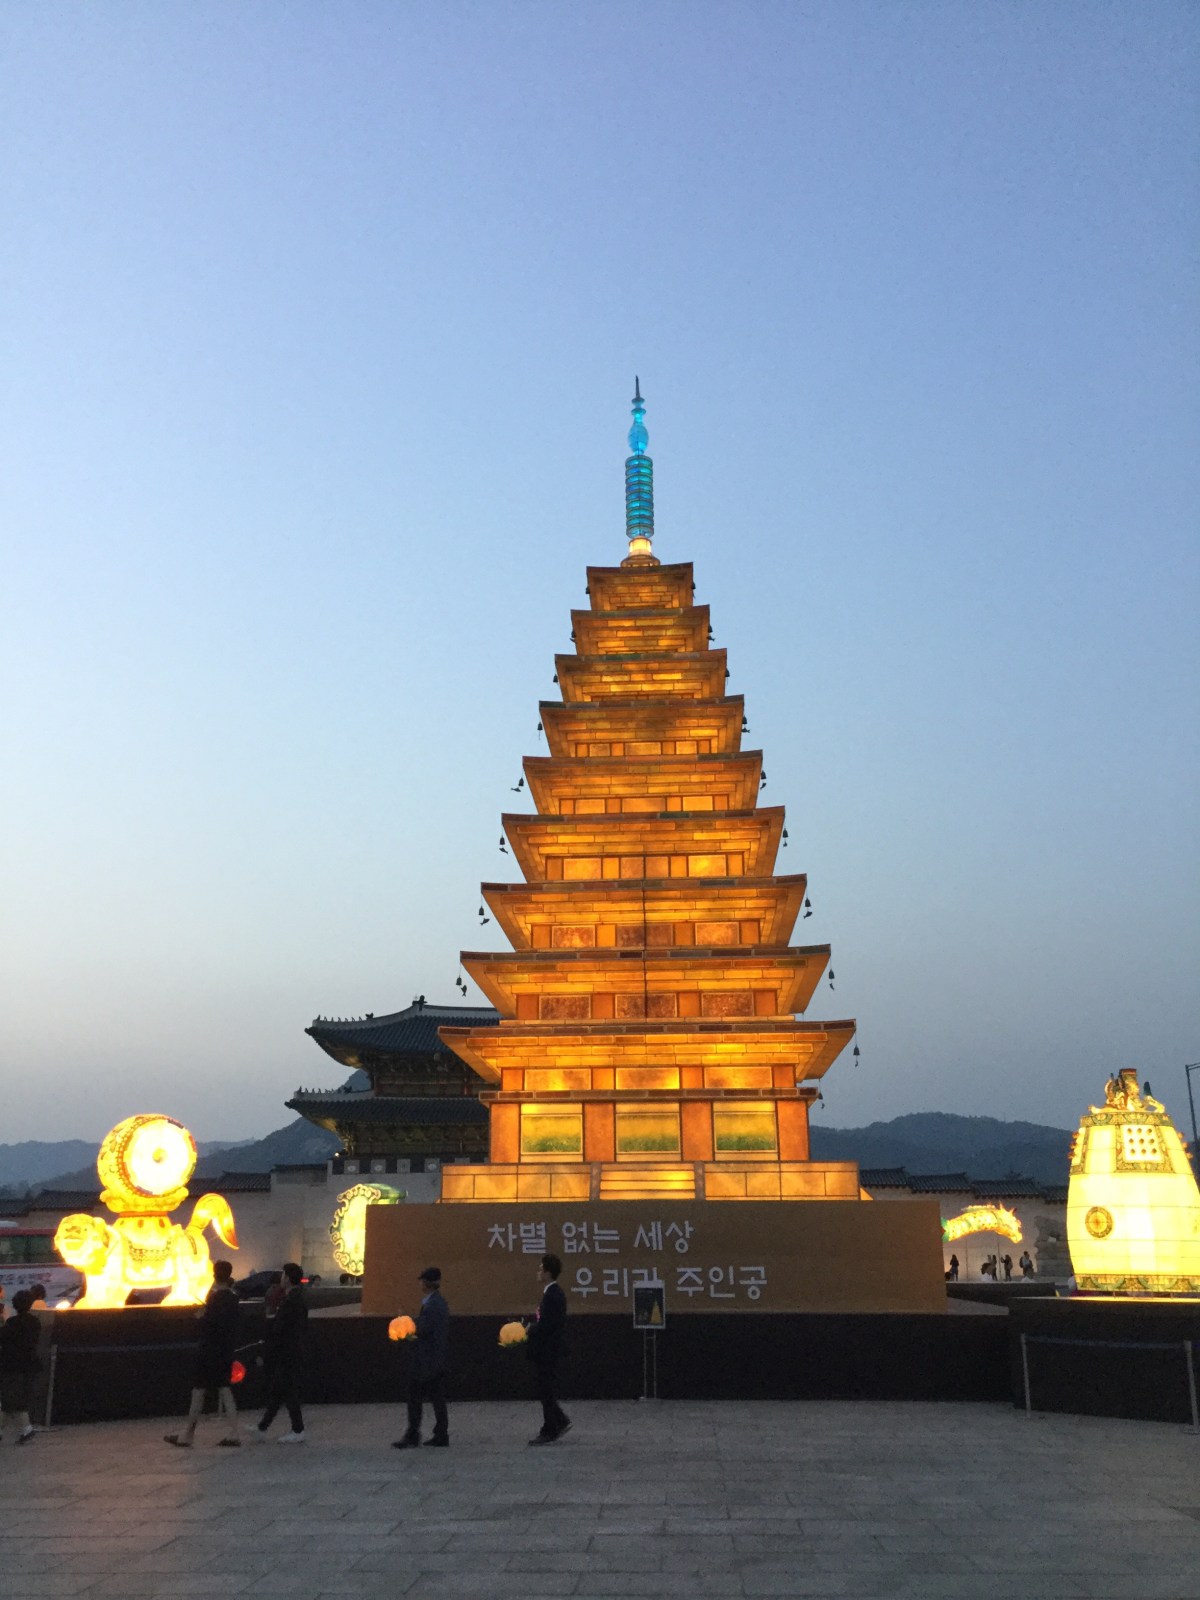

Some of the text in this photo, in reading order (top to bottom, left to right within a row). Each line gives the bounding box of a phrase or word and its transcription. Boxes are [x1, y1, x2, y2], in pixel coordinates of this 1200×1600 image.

[487, 1221, 693, 1254] 차별 없는 세상
[676, 1267, 768, 1300] 주인공
